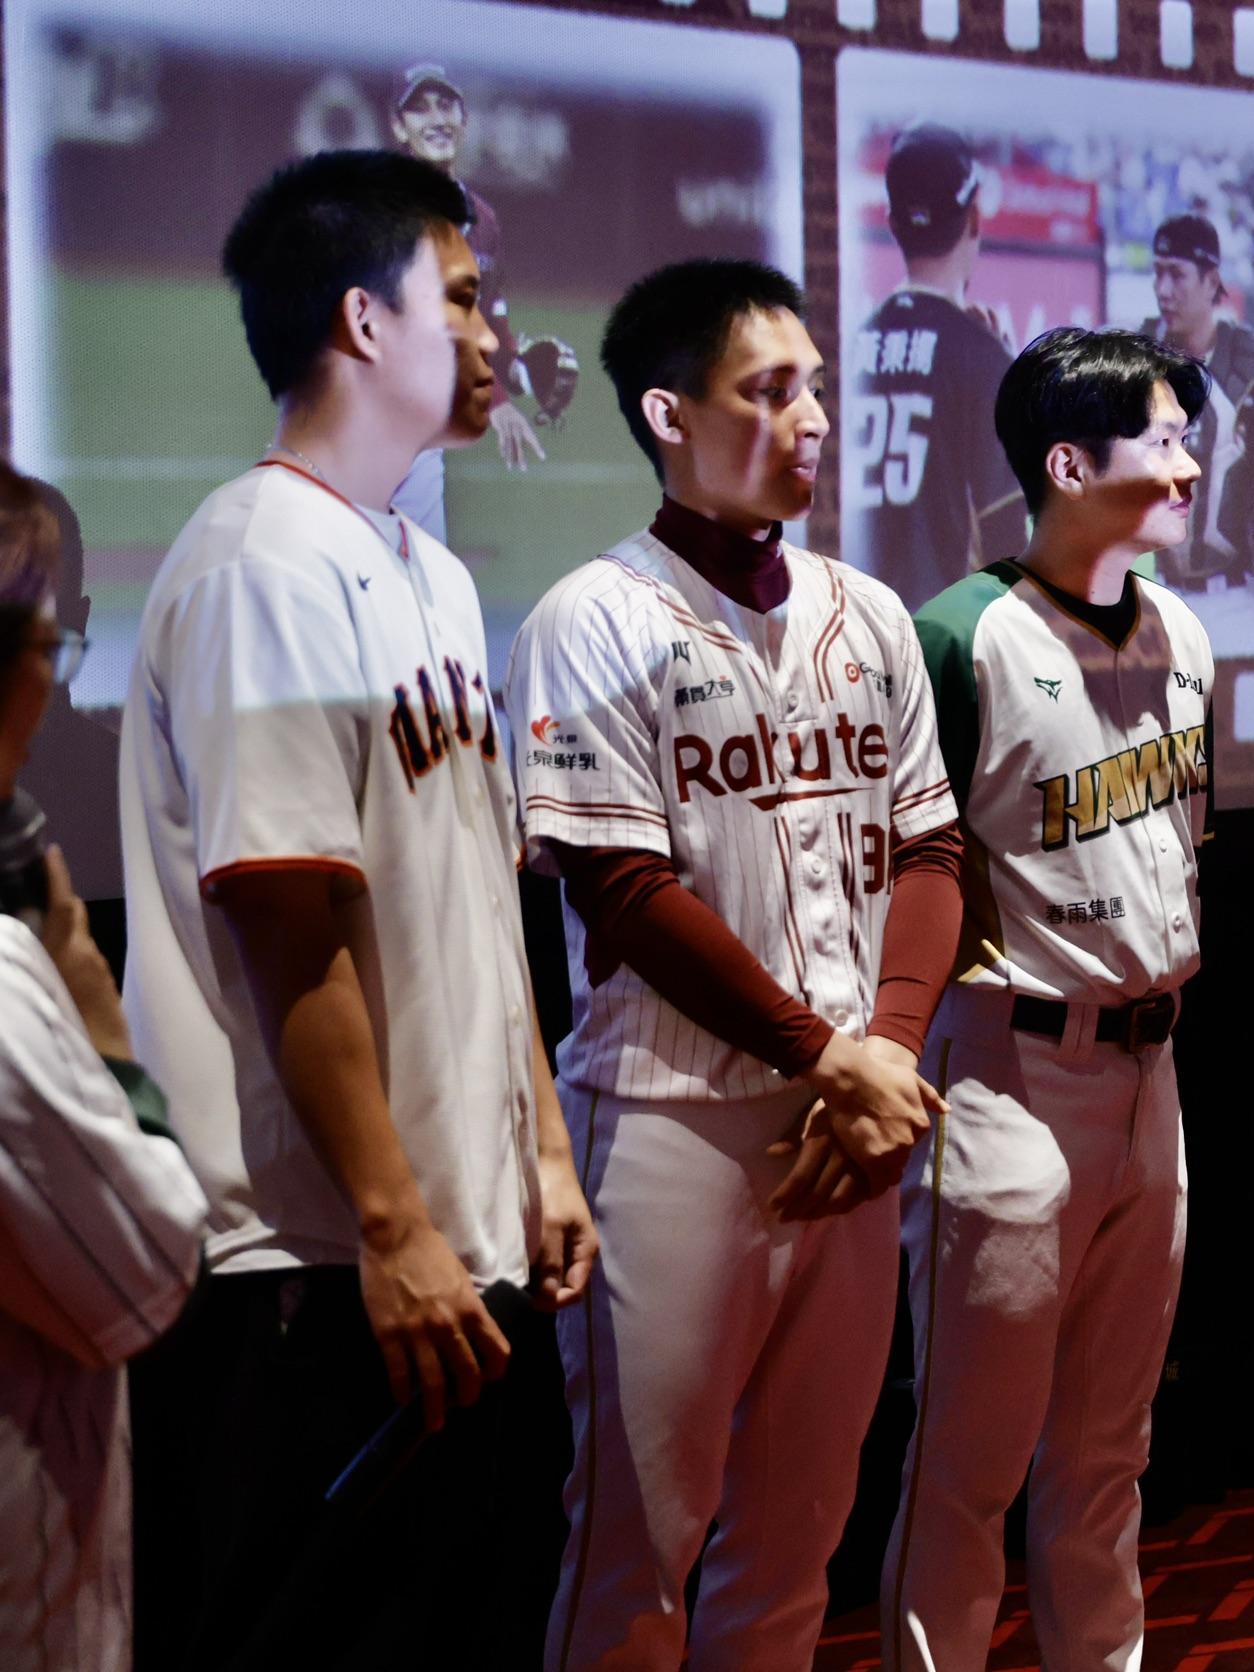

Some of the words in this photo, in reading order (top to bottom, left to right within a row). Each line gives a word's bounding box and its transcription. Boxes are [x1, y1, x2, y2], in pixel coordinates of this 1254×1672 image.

[854, 394, 934, 505] 25
[1045, 896, 1126, 924] 春雨集團
